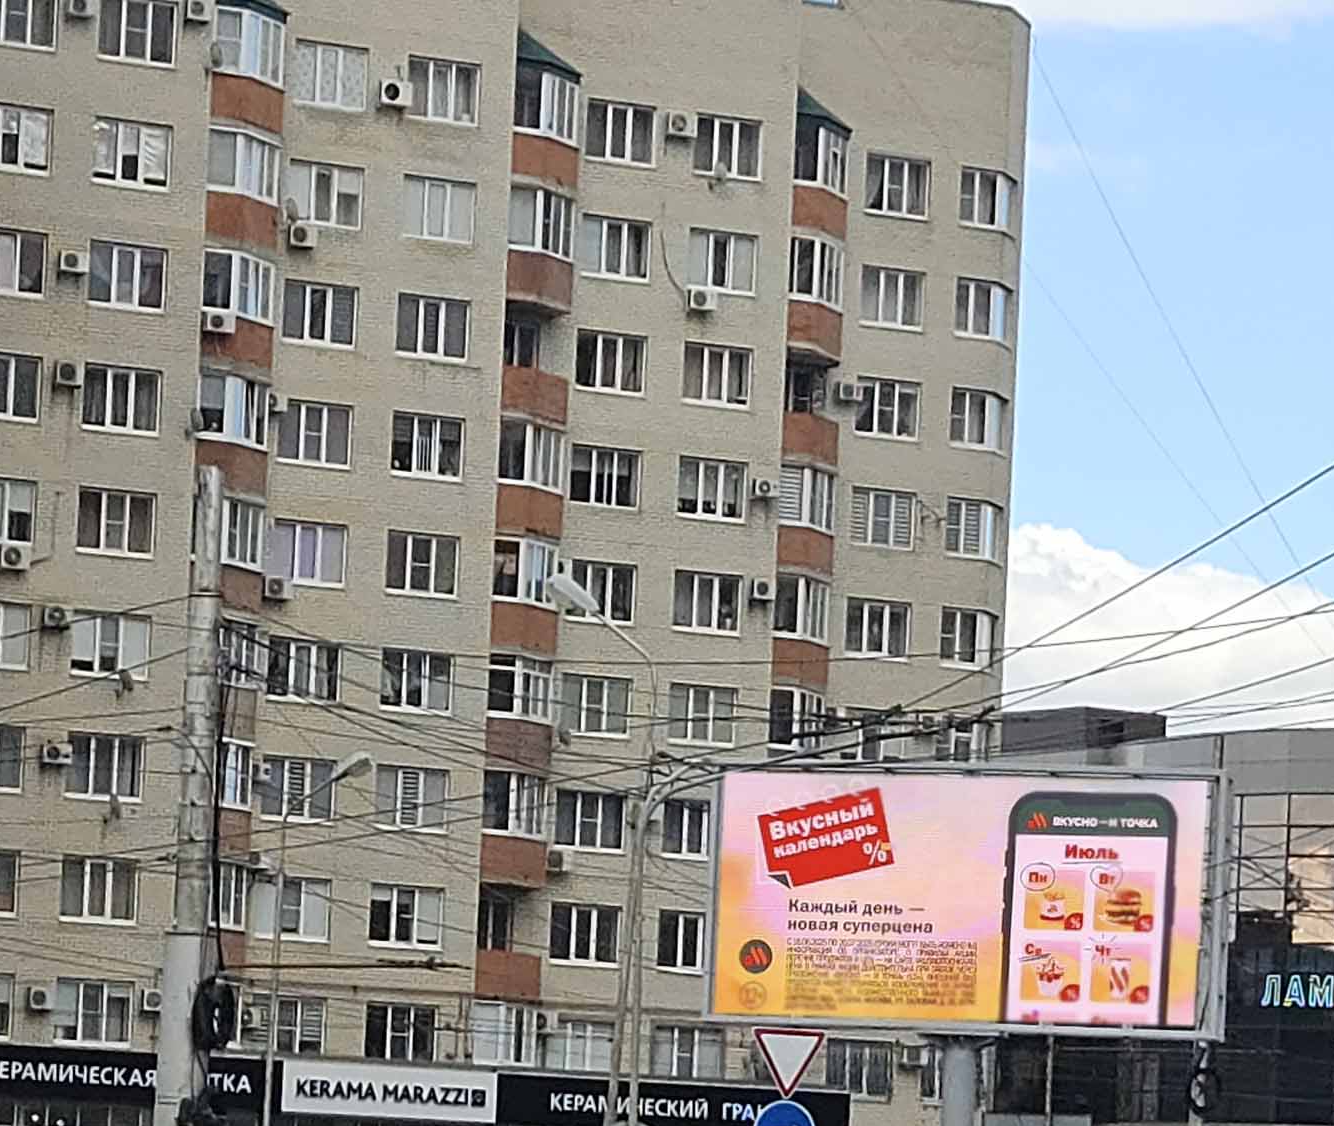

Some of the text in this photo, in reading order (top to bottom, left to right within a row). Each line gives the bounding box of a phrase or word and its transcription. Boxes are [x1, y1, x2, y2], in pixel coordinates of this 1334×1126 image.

[769, 799, 875, 840] Вкусный
[1053, 816, 1099, 827] ВКУСНО
[1120, 817, 1159, 828] ТОЧКА
[773, 823, 879, 858] календарь
[1065, 844, 1120, 860] Июль
[788, 898, 858, 916] Каждый
[862, 902, 904, 917] день
[787, 919, 934, 935] новая суперцена
[296, 1078, 469, 1106] KERAMA MARAZZI
